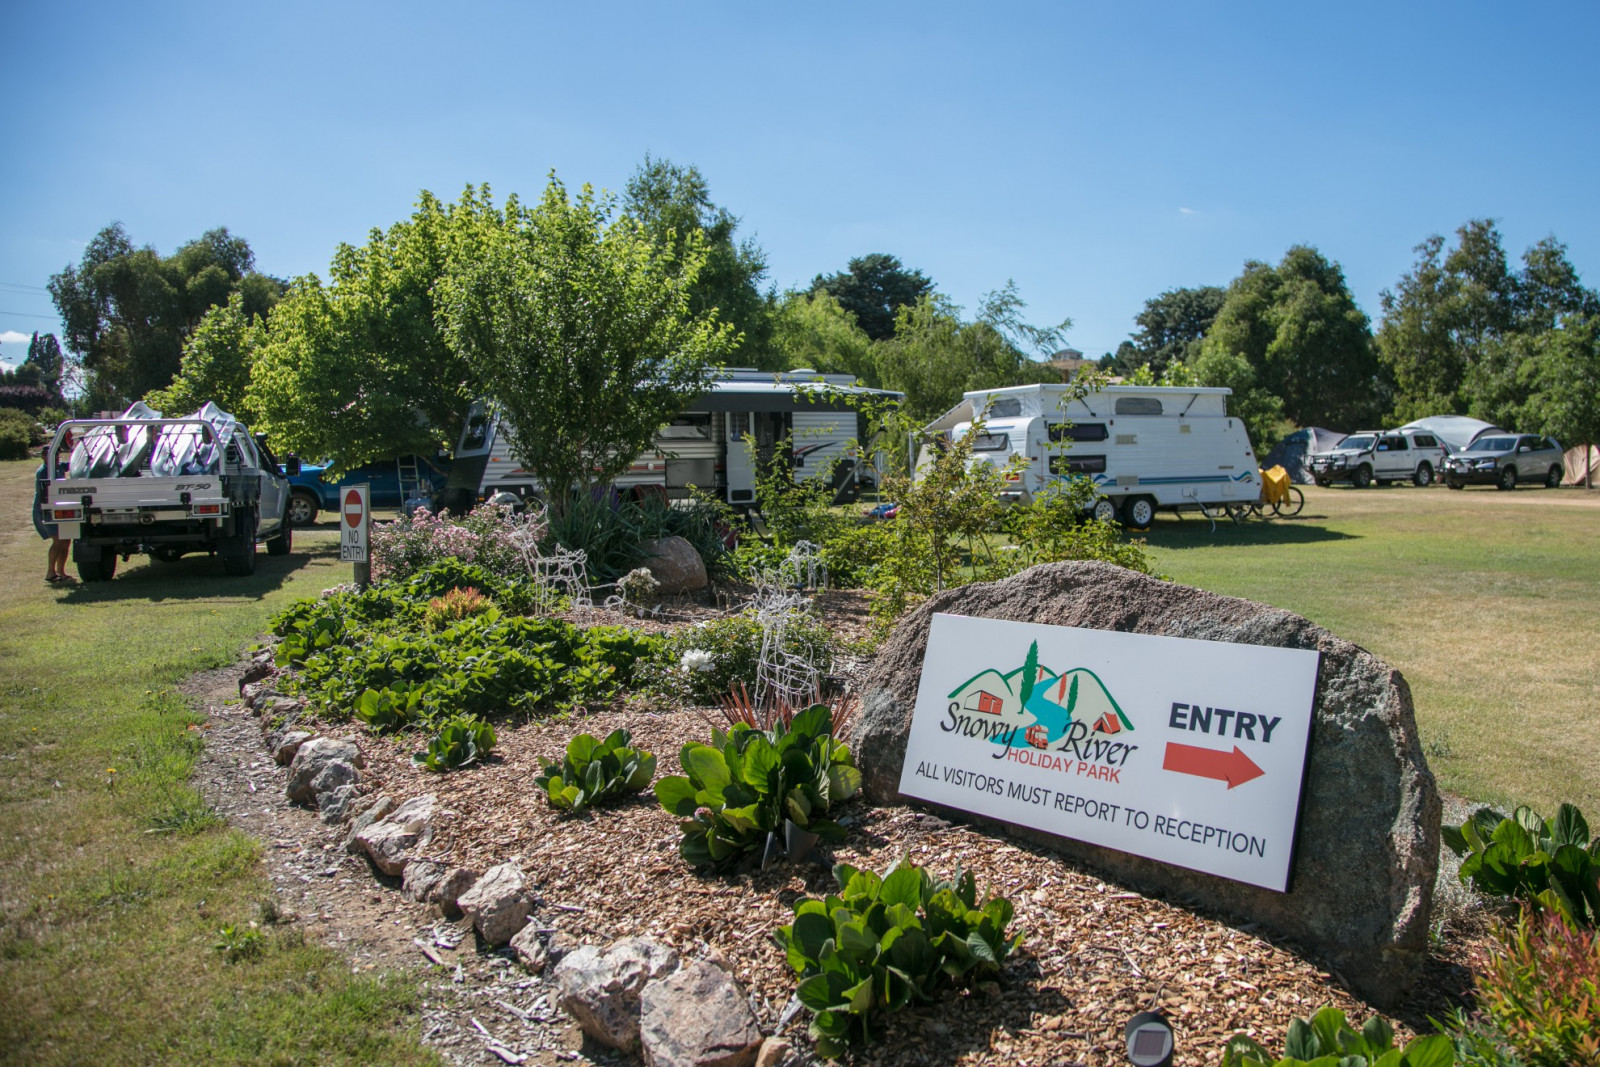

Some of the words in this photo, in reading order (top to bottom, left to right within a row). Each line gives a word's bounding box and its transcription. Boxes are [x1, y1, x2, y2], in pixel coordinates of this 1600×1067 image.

[342, 545, 365, 560] ENTRY
[348, 530, 360, 544] NO
[940, 701, 1019, 760] Snowy
[1056, 718, 1139, 767] River
[1168, 702, 1281, 743] ENTRY
[1007, 747, 1073, 774] HOLIDAY
[1076, 761, 1122, 784] PARK
[915, 760, 940, 781] ALL
[943, 766, 1004, 795] VISITORS
[1007, 781, 1052, 807] MUST
[1054, 794, 1121, 823] REPORT
[1124, 807, 1150, 830] TO
[1153, 815, 1267, 858] RECEPTION
